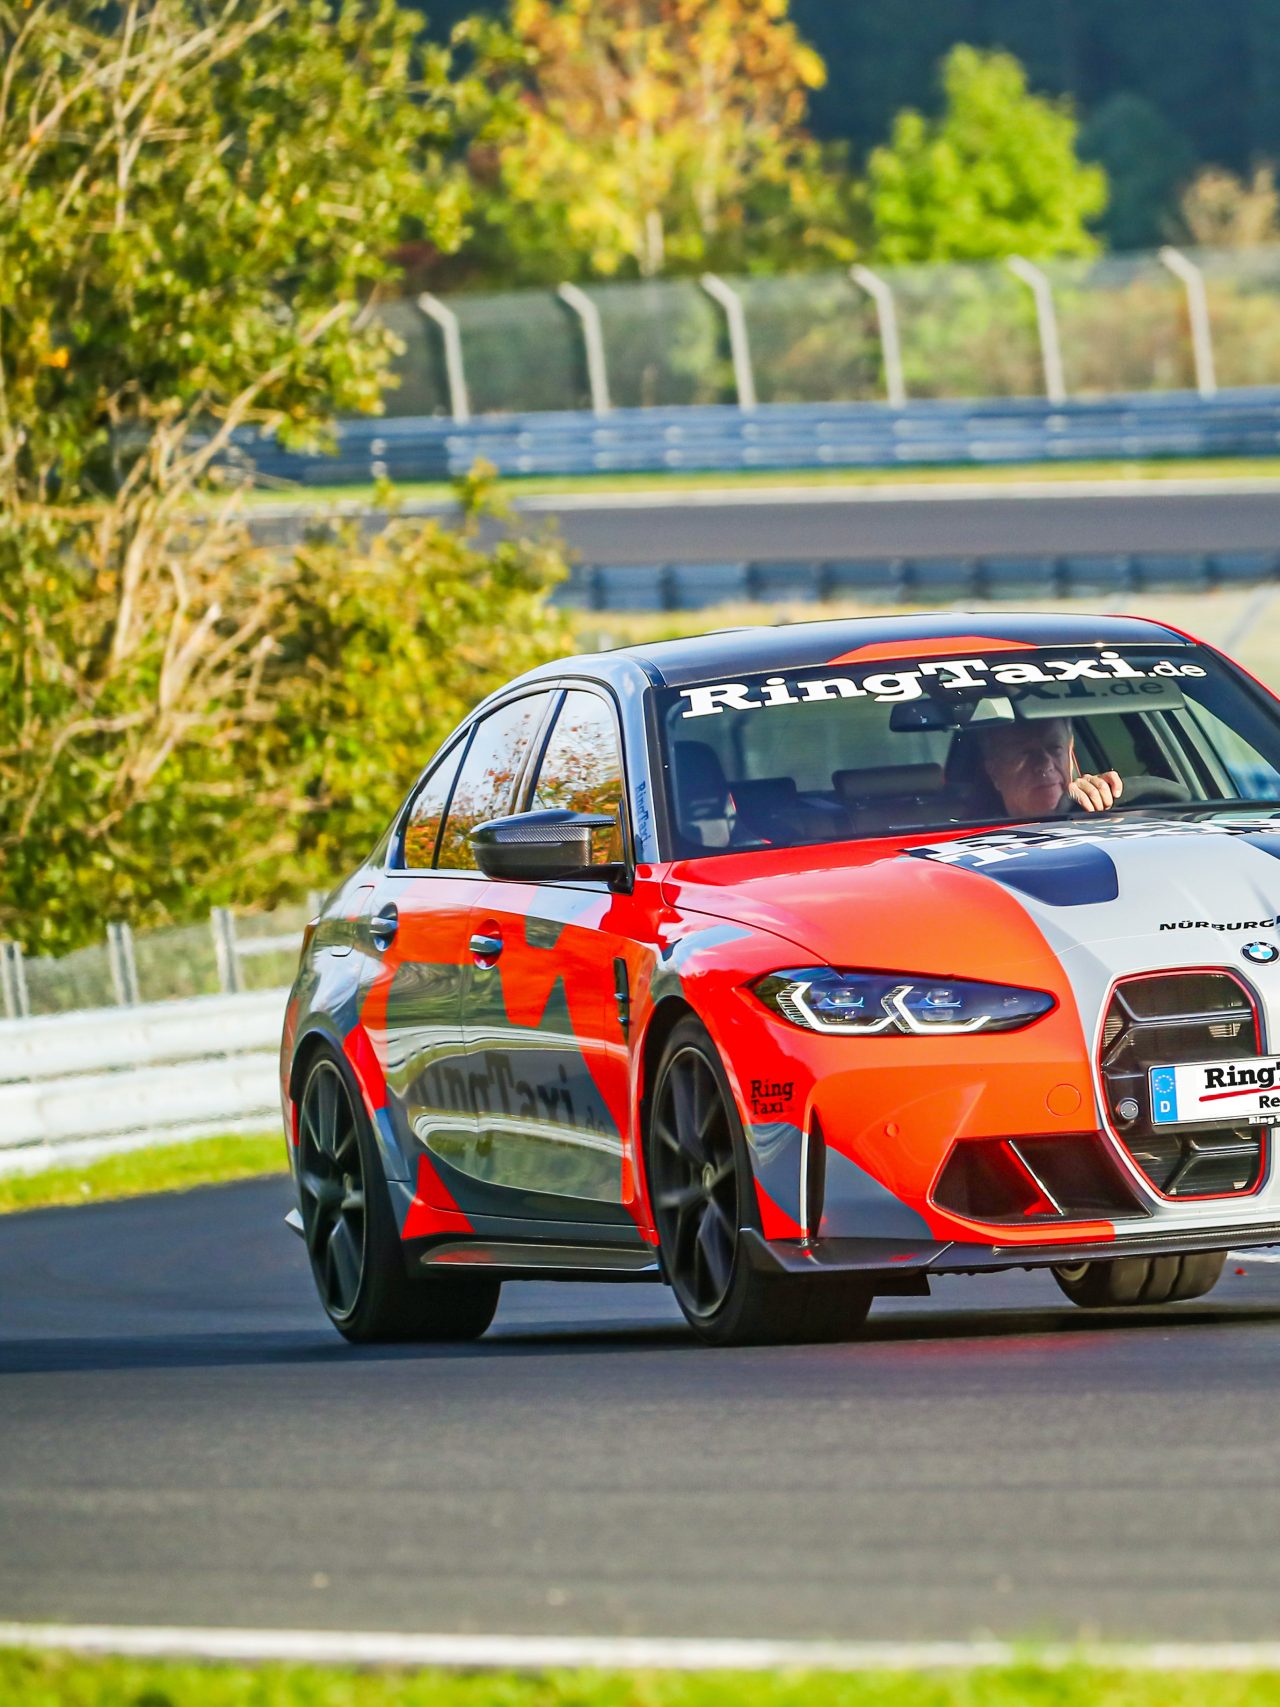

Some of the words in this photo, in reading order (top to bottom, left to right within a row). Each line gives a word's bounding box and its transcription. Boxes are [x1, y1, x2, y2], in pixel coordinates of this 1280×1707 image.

[679, 651, 1207, 719] RingTaxi.de
[751, 1079, 794, 1101] Ring
[751, 1098, 784, 1115] Taxi
[1160, 1101, 1170, 1113] D
